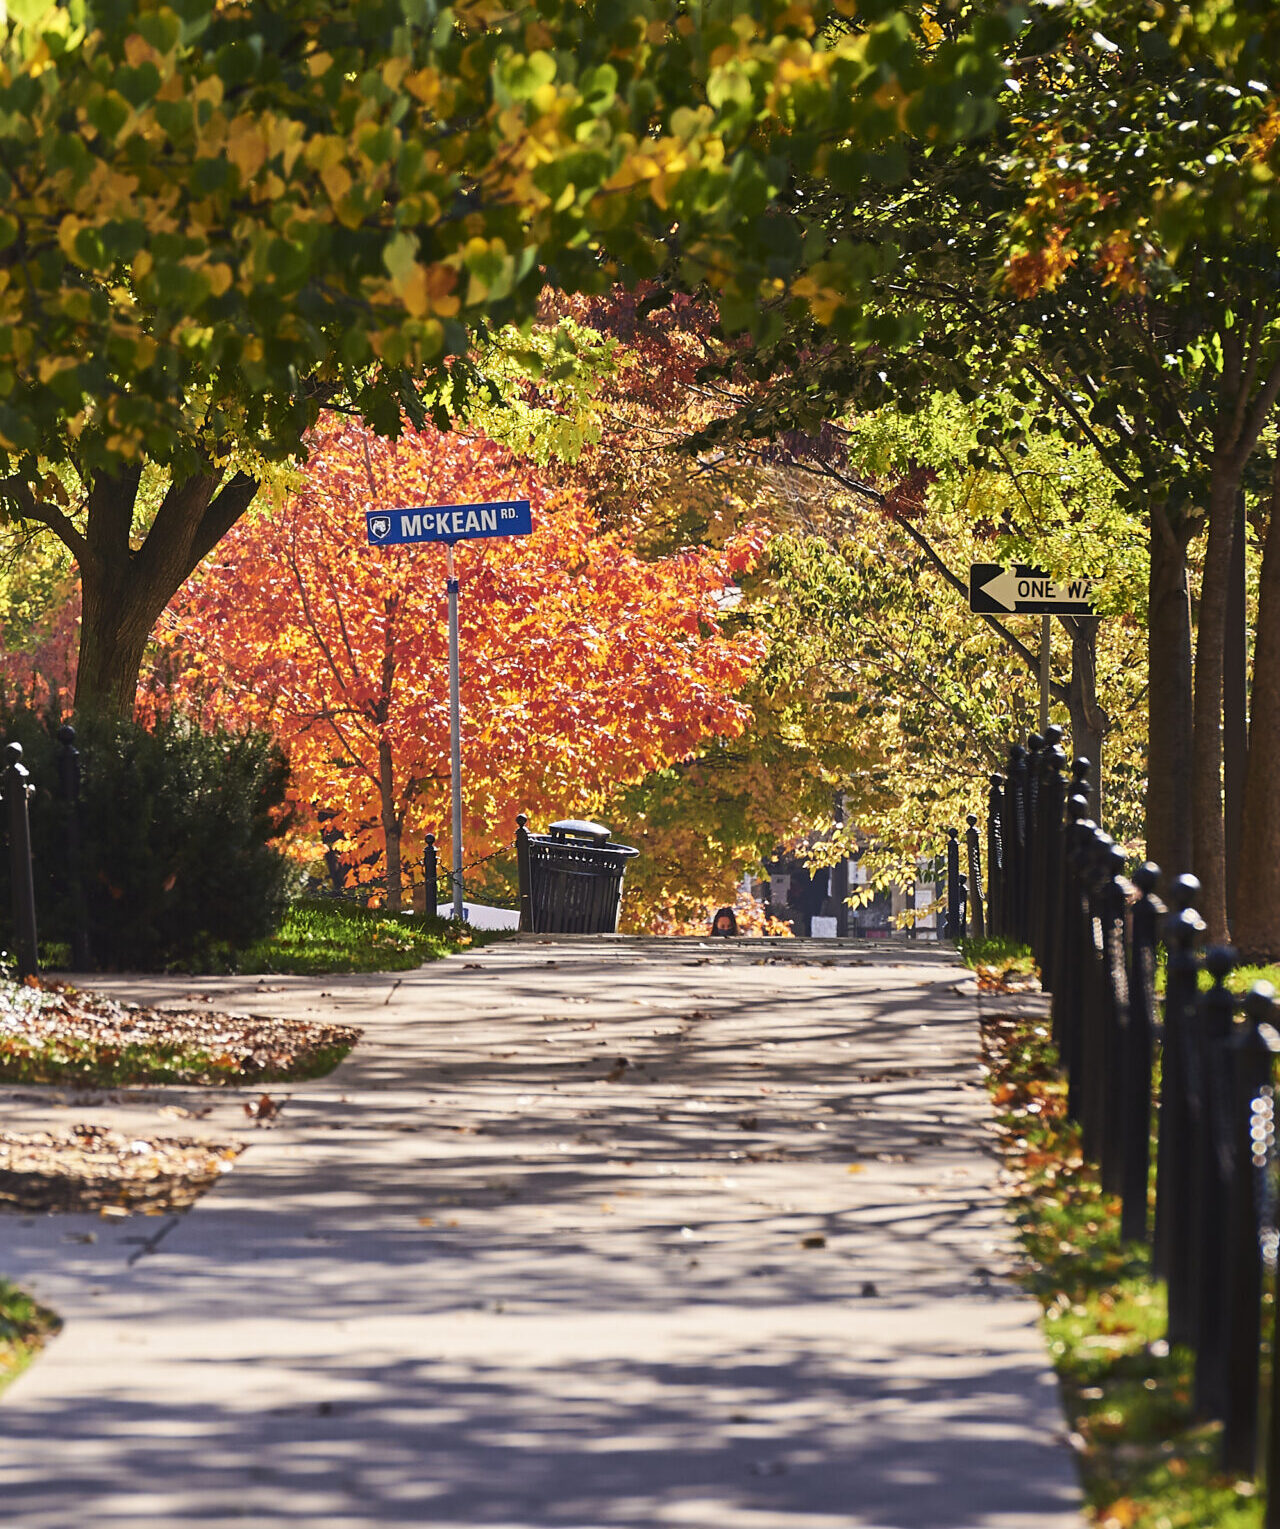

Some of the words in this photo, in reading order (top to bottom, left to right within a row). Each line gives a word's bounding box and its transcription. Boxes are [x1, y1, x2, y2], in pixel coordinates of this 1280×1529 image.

[500, 507, 519, 520] RD.
[1017, 580, 1056, 598] ONE
[1067, 581, 1094, 598] WA
